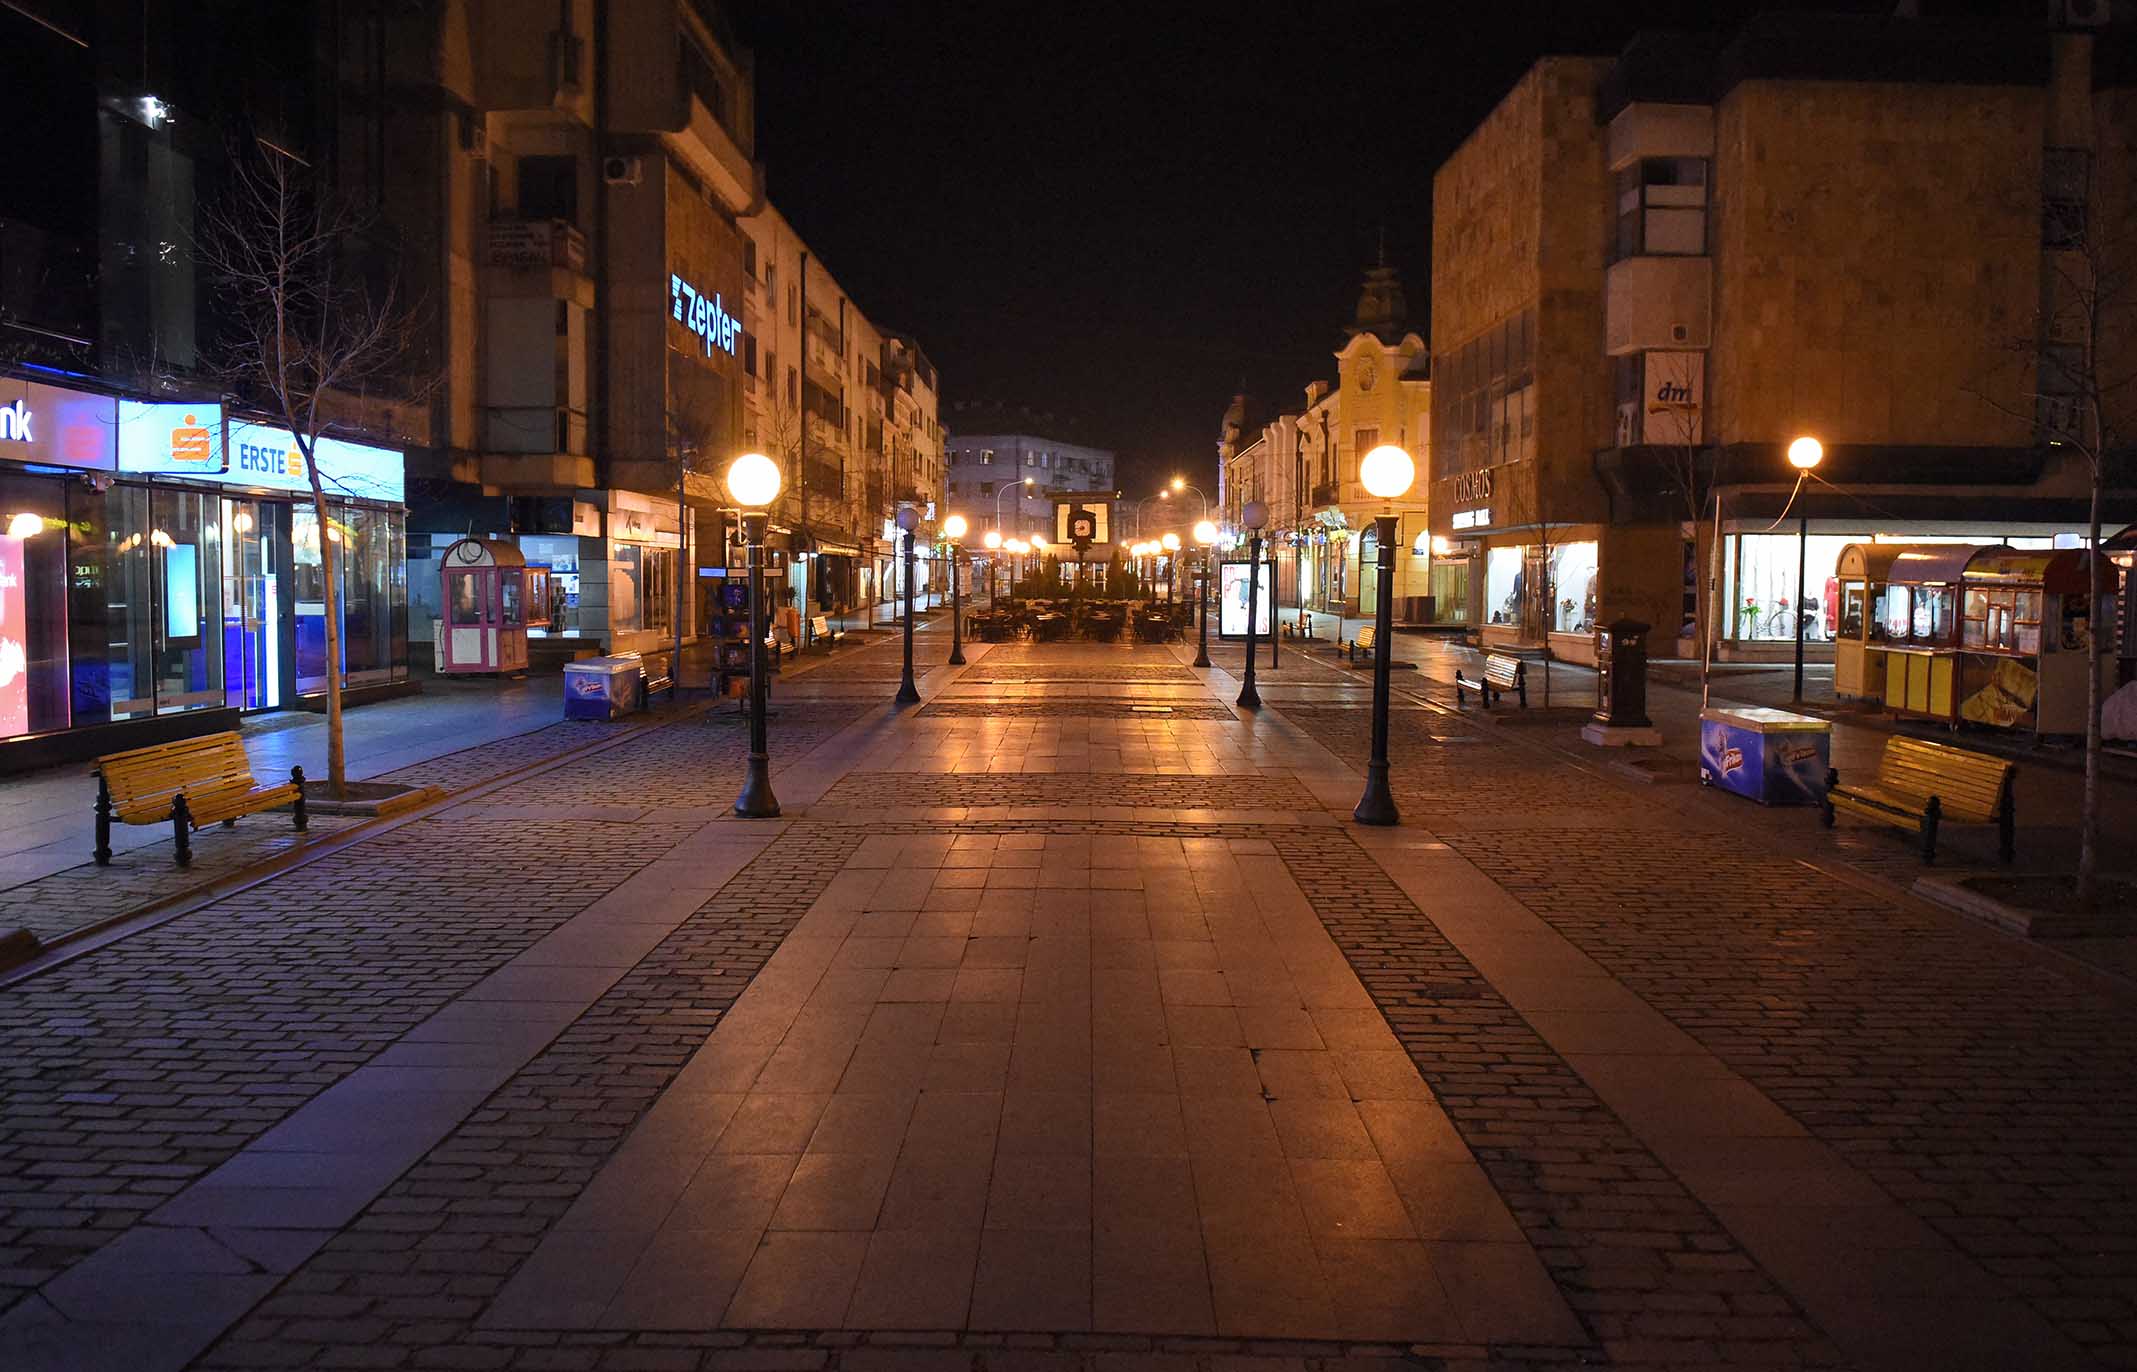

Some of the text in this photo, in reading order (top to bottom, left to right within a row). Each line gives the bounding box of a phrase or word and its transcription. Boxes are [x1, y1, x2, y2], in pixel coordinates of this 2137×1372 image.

[682, 281, 742, 358] Zepter
[1658, 382, 1692, 401] dm
[240, 444, 286, 474] ERSTE
